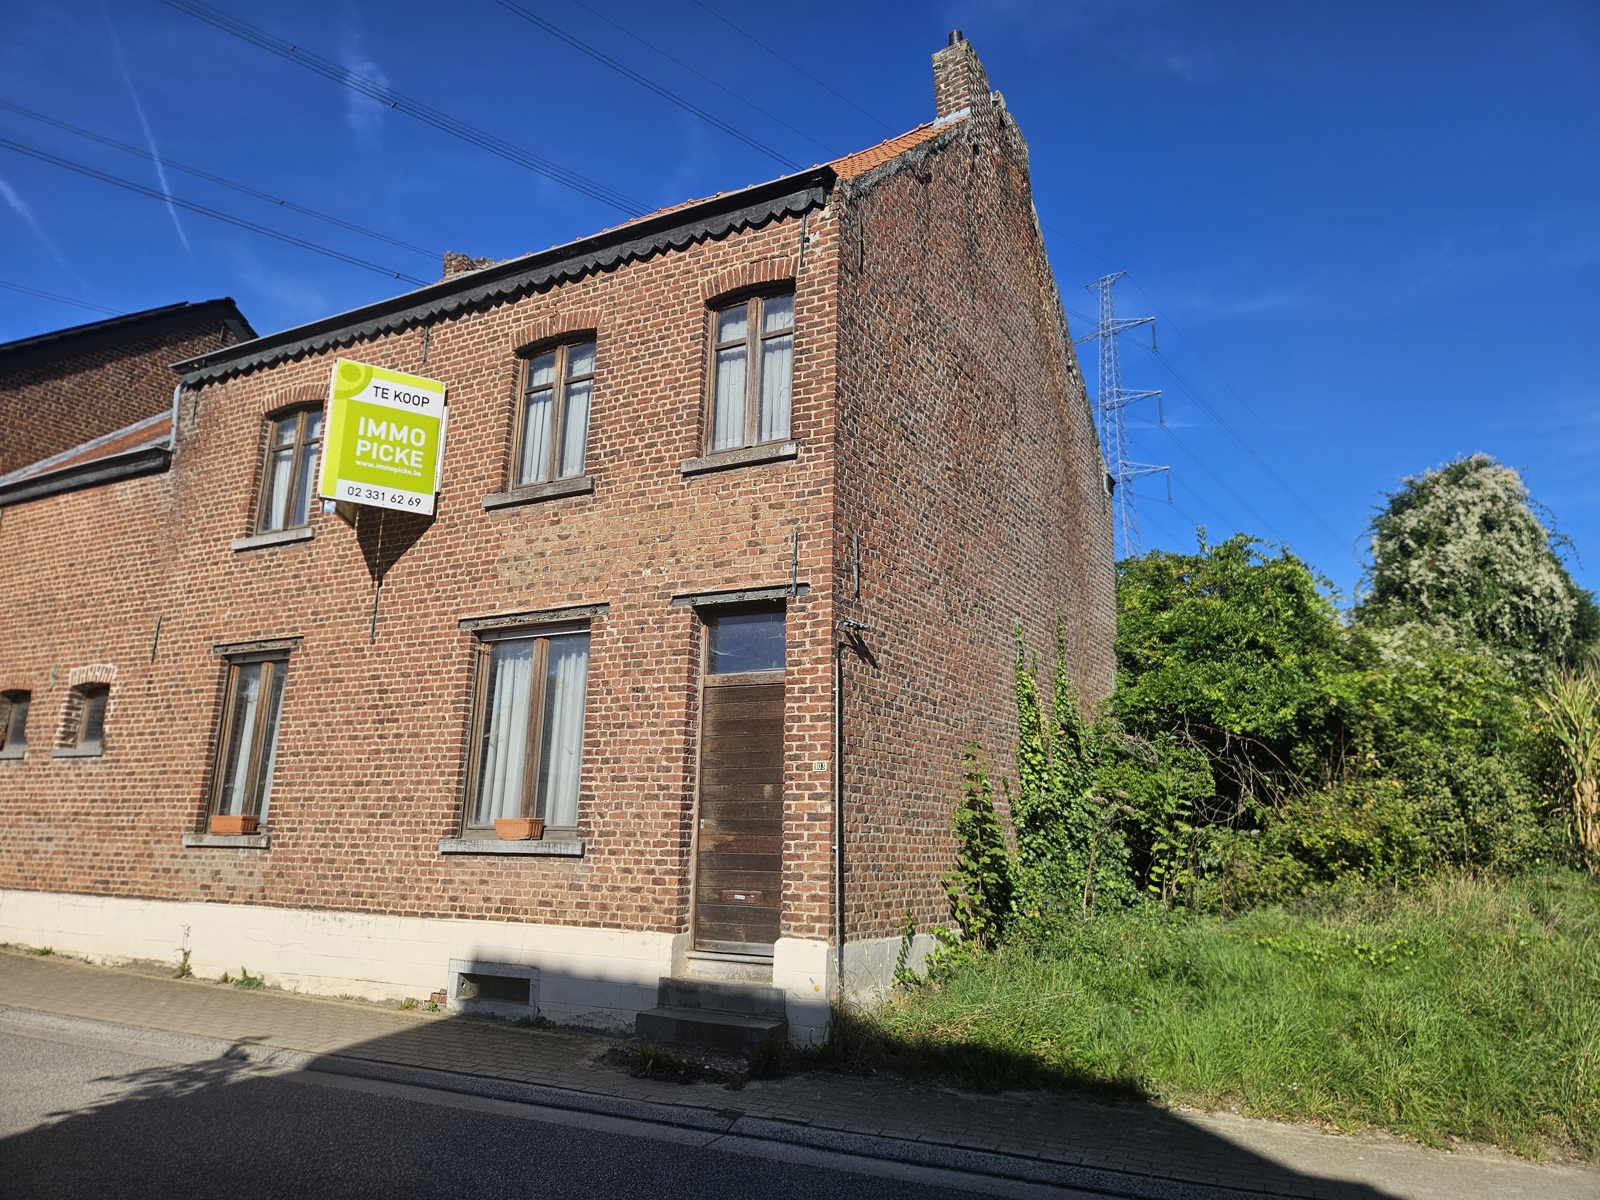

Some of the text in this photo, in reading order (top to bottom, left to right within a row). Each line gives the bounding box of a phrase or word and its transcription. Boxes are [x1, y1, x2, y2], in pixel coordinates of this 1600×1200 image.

[373, 385, 430, 407] TE KOOP
[358, 416, 425, 447] IMMO
[355, 439, 424, 468] PICKE
[355, 460, 421, 476] www.immopicke.be
[347, 486, 422, 508] 02 331 62 69
